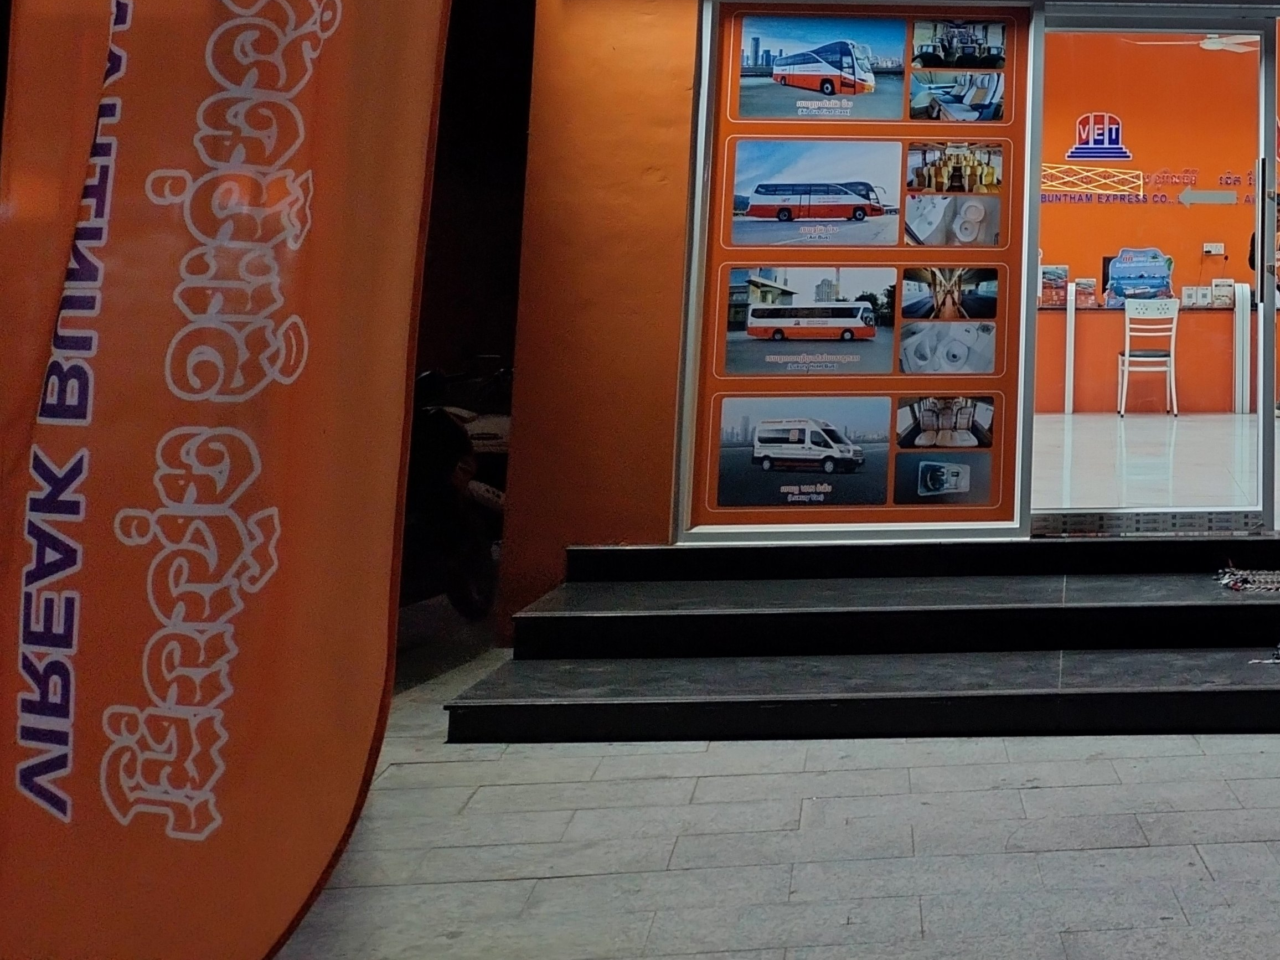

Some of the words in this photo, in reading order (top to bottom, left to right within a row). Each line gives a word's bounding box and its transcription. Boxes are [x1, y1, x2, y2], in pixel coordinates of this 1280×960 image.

[1079, 125, 1119, 139] VET
[1041, 194, 1093, 203] BUNTHAM
[1098, 194, 1147, 204] EXPRESS
